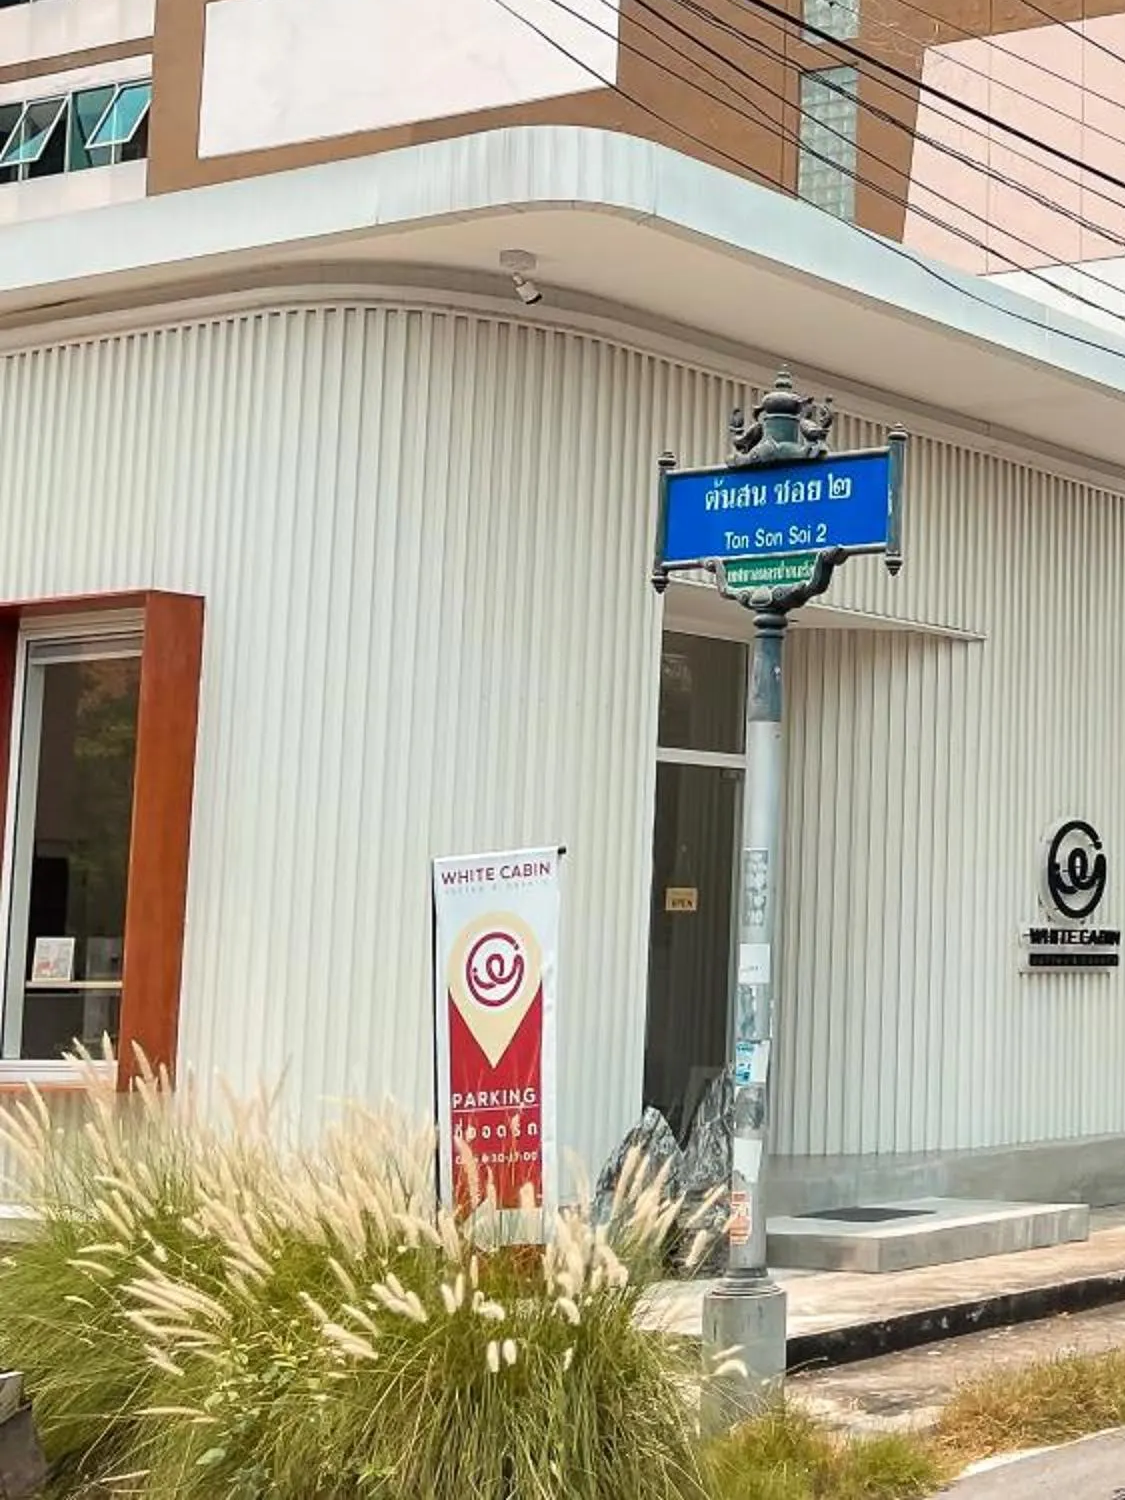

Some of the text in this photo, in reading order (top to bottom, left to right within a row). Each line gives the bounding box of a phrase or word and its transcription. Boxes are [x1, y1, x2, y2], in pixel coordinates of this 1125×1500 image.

[705, 473, 852, 511] ต้นสน ซอย ๒
[725, 523, 828, 550] Ton Son Soi 2
[441, 861, 551, 885] WHITE CABIN
[1029, 928, 1079, 945] WHITE
[453, 1087, 537, 1109] PARKING
